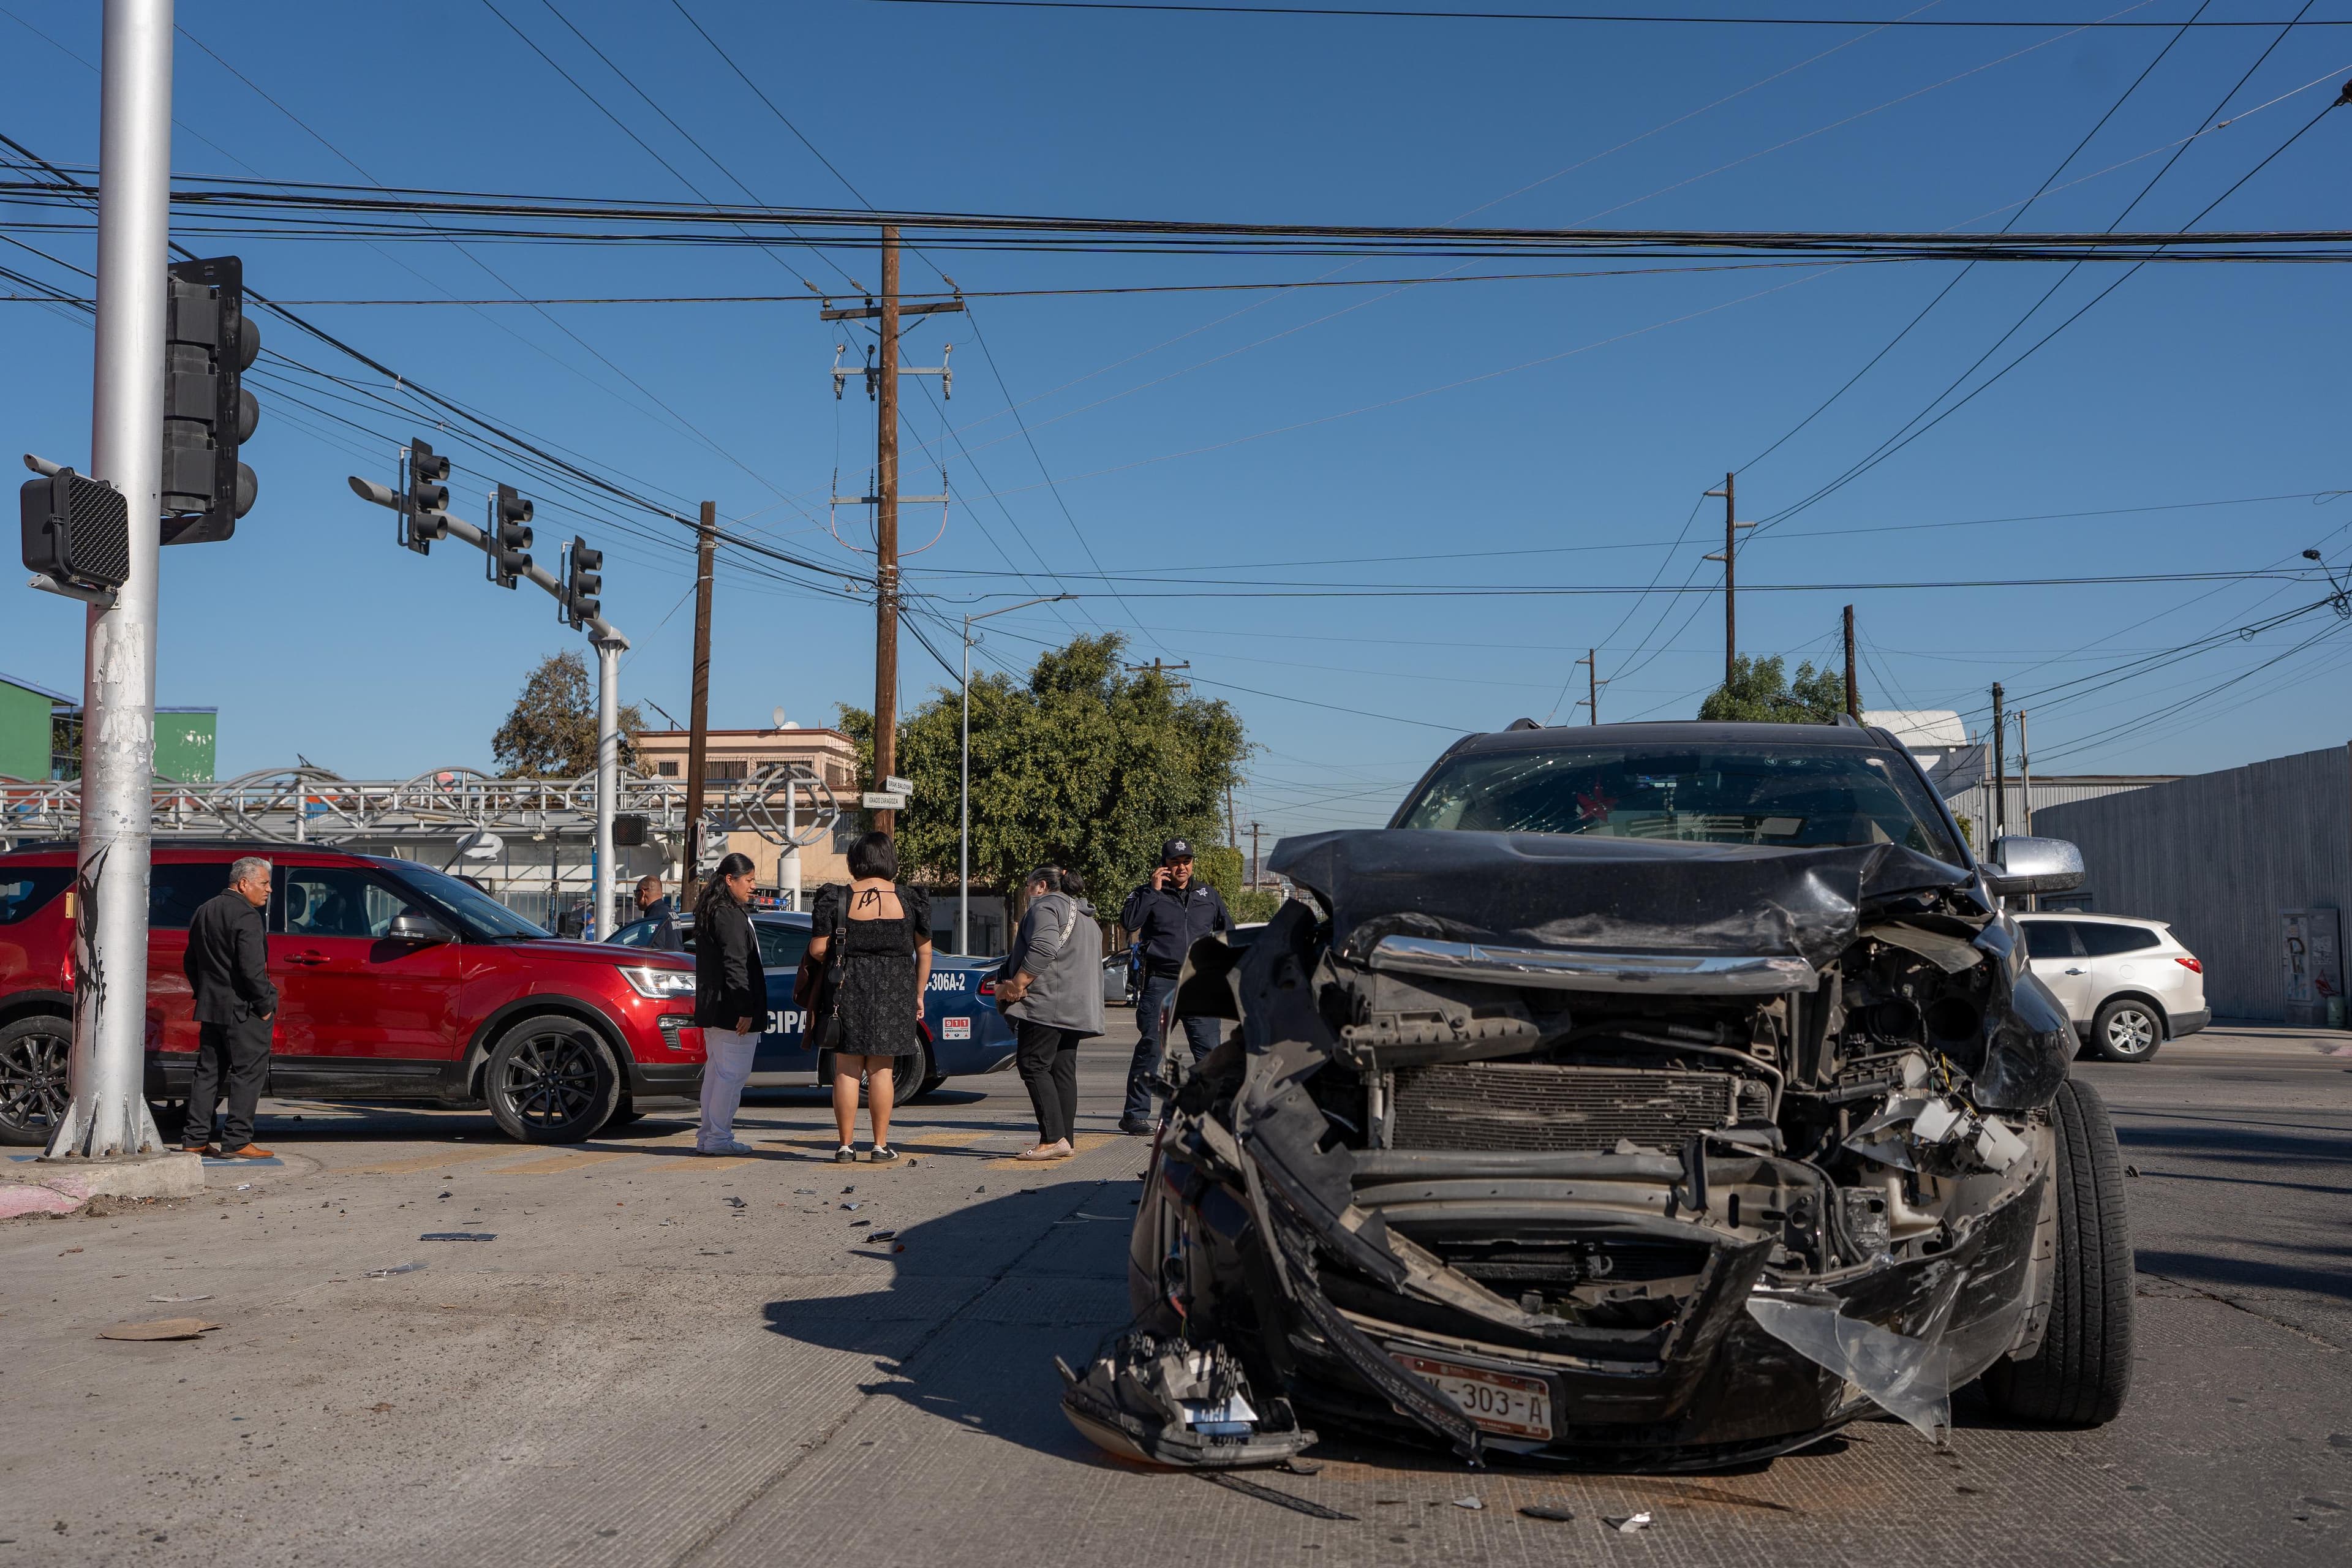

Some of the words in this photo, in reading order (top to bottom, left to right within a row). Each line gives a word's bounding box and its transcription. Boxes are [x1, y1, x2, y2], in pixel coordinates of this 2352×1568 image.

[897, 782, 911, 791] BALOYAN
[924, 973, 965, 991] -306A-2
[1422, 1376, 1542, 1425] -303-A
